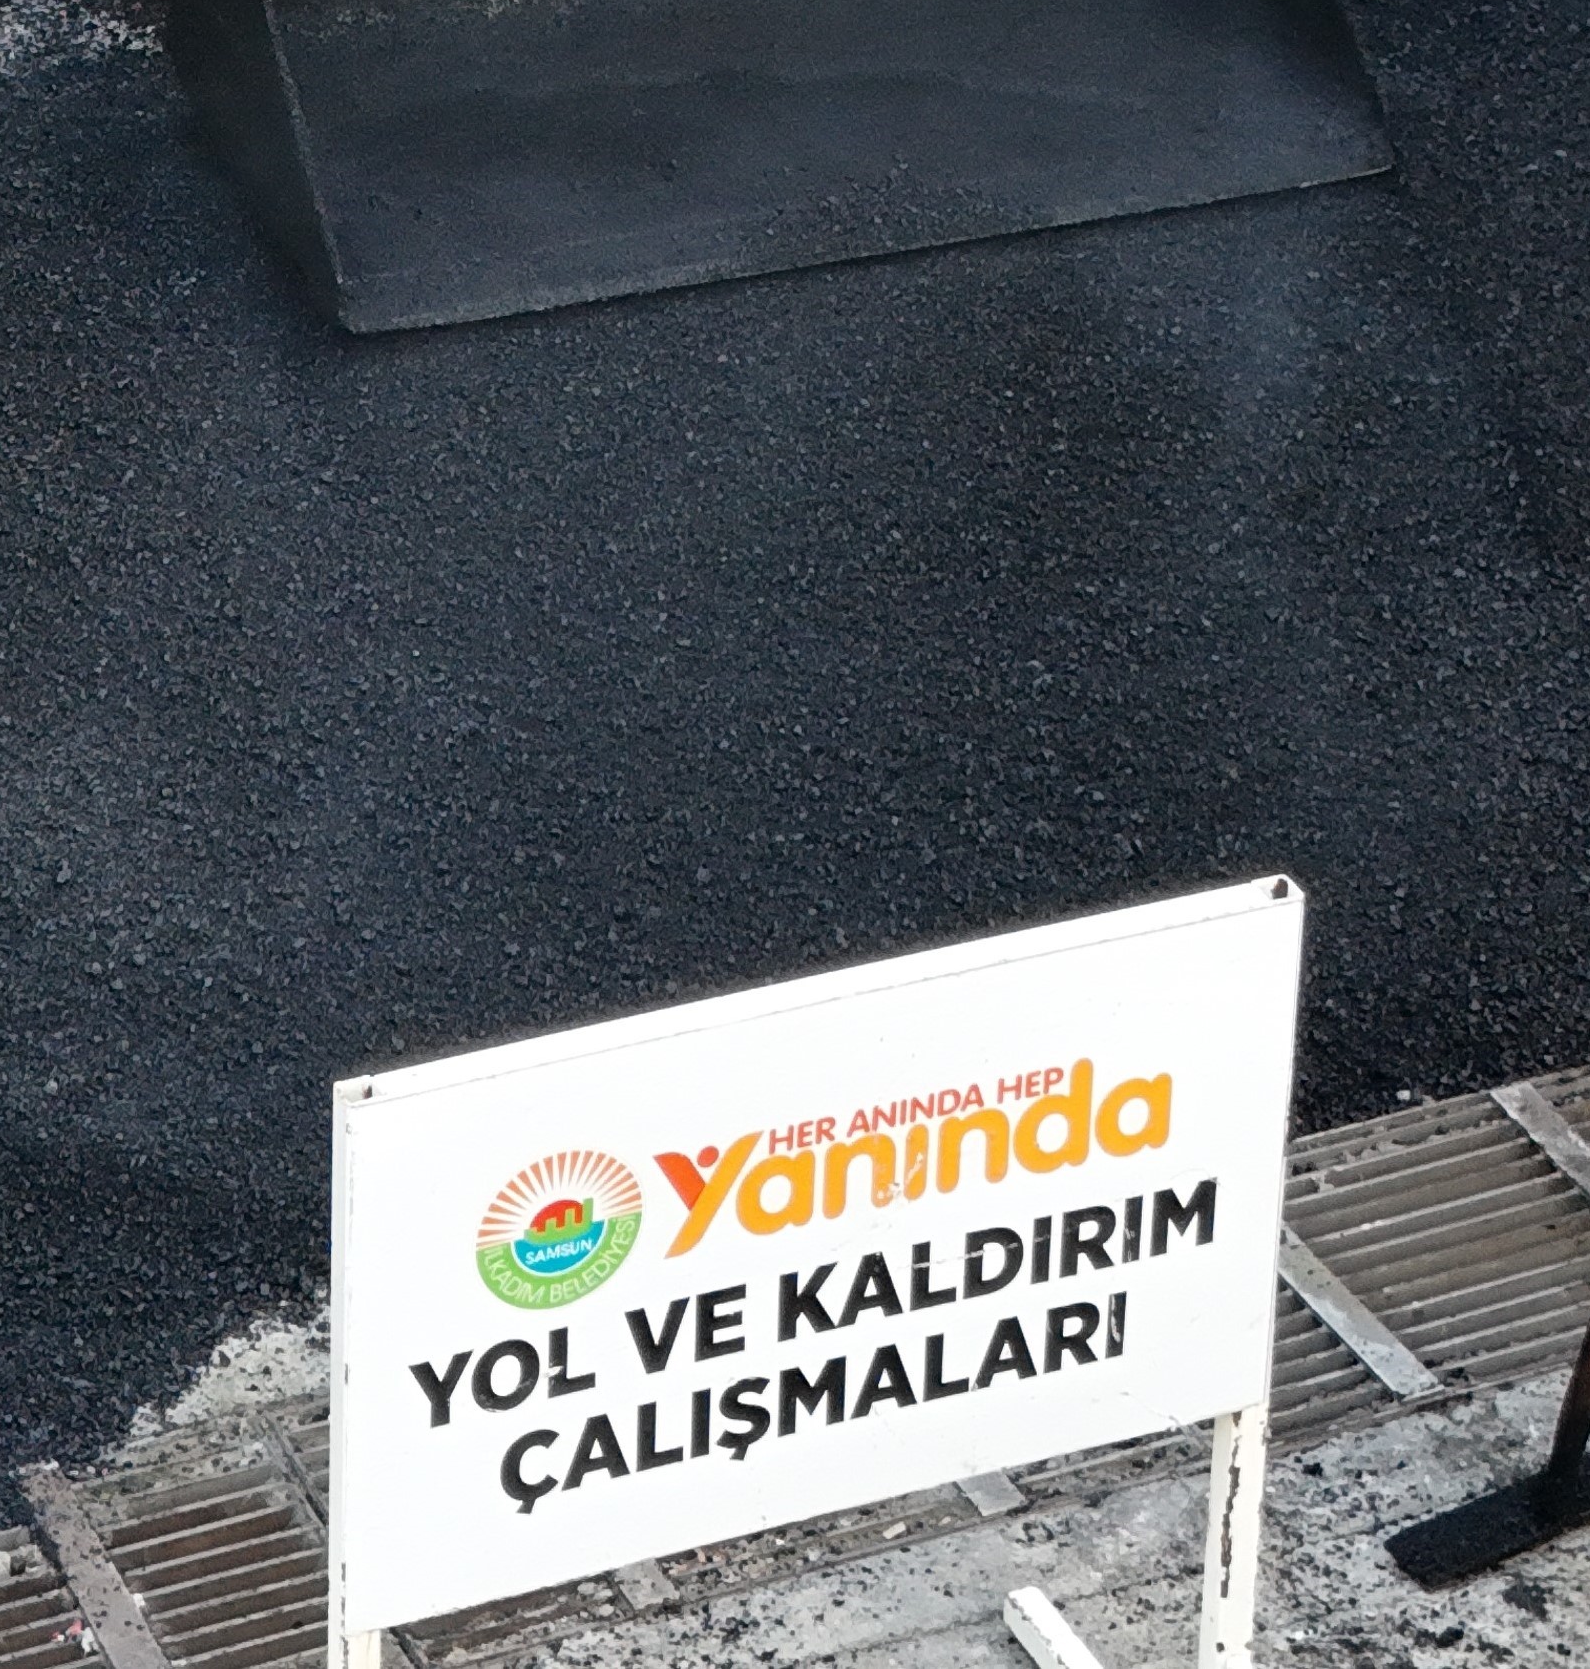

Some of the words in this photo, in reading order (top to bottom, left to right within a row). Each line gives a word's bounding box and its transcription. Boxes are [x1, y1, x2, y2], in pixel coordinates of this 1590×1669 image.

[768, 1116, 837, 1155] HER
[846, 1084, 985, 1137] ANINDA
[997, 1067, 1065, 1102] HEP
[408, 1328, 596, 1428] YOL
[624, 1283, 747, 1374] VE
[778, 1177, 1220, 1343] KALDIRIM
[525, 1238, 595, 1265] SAMSUN
[499, 1291, 1129, 1515] ÇALIŞMALARI
